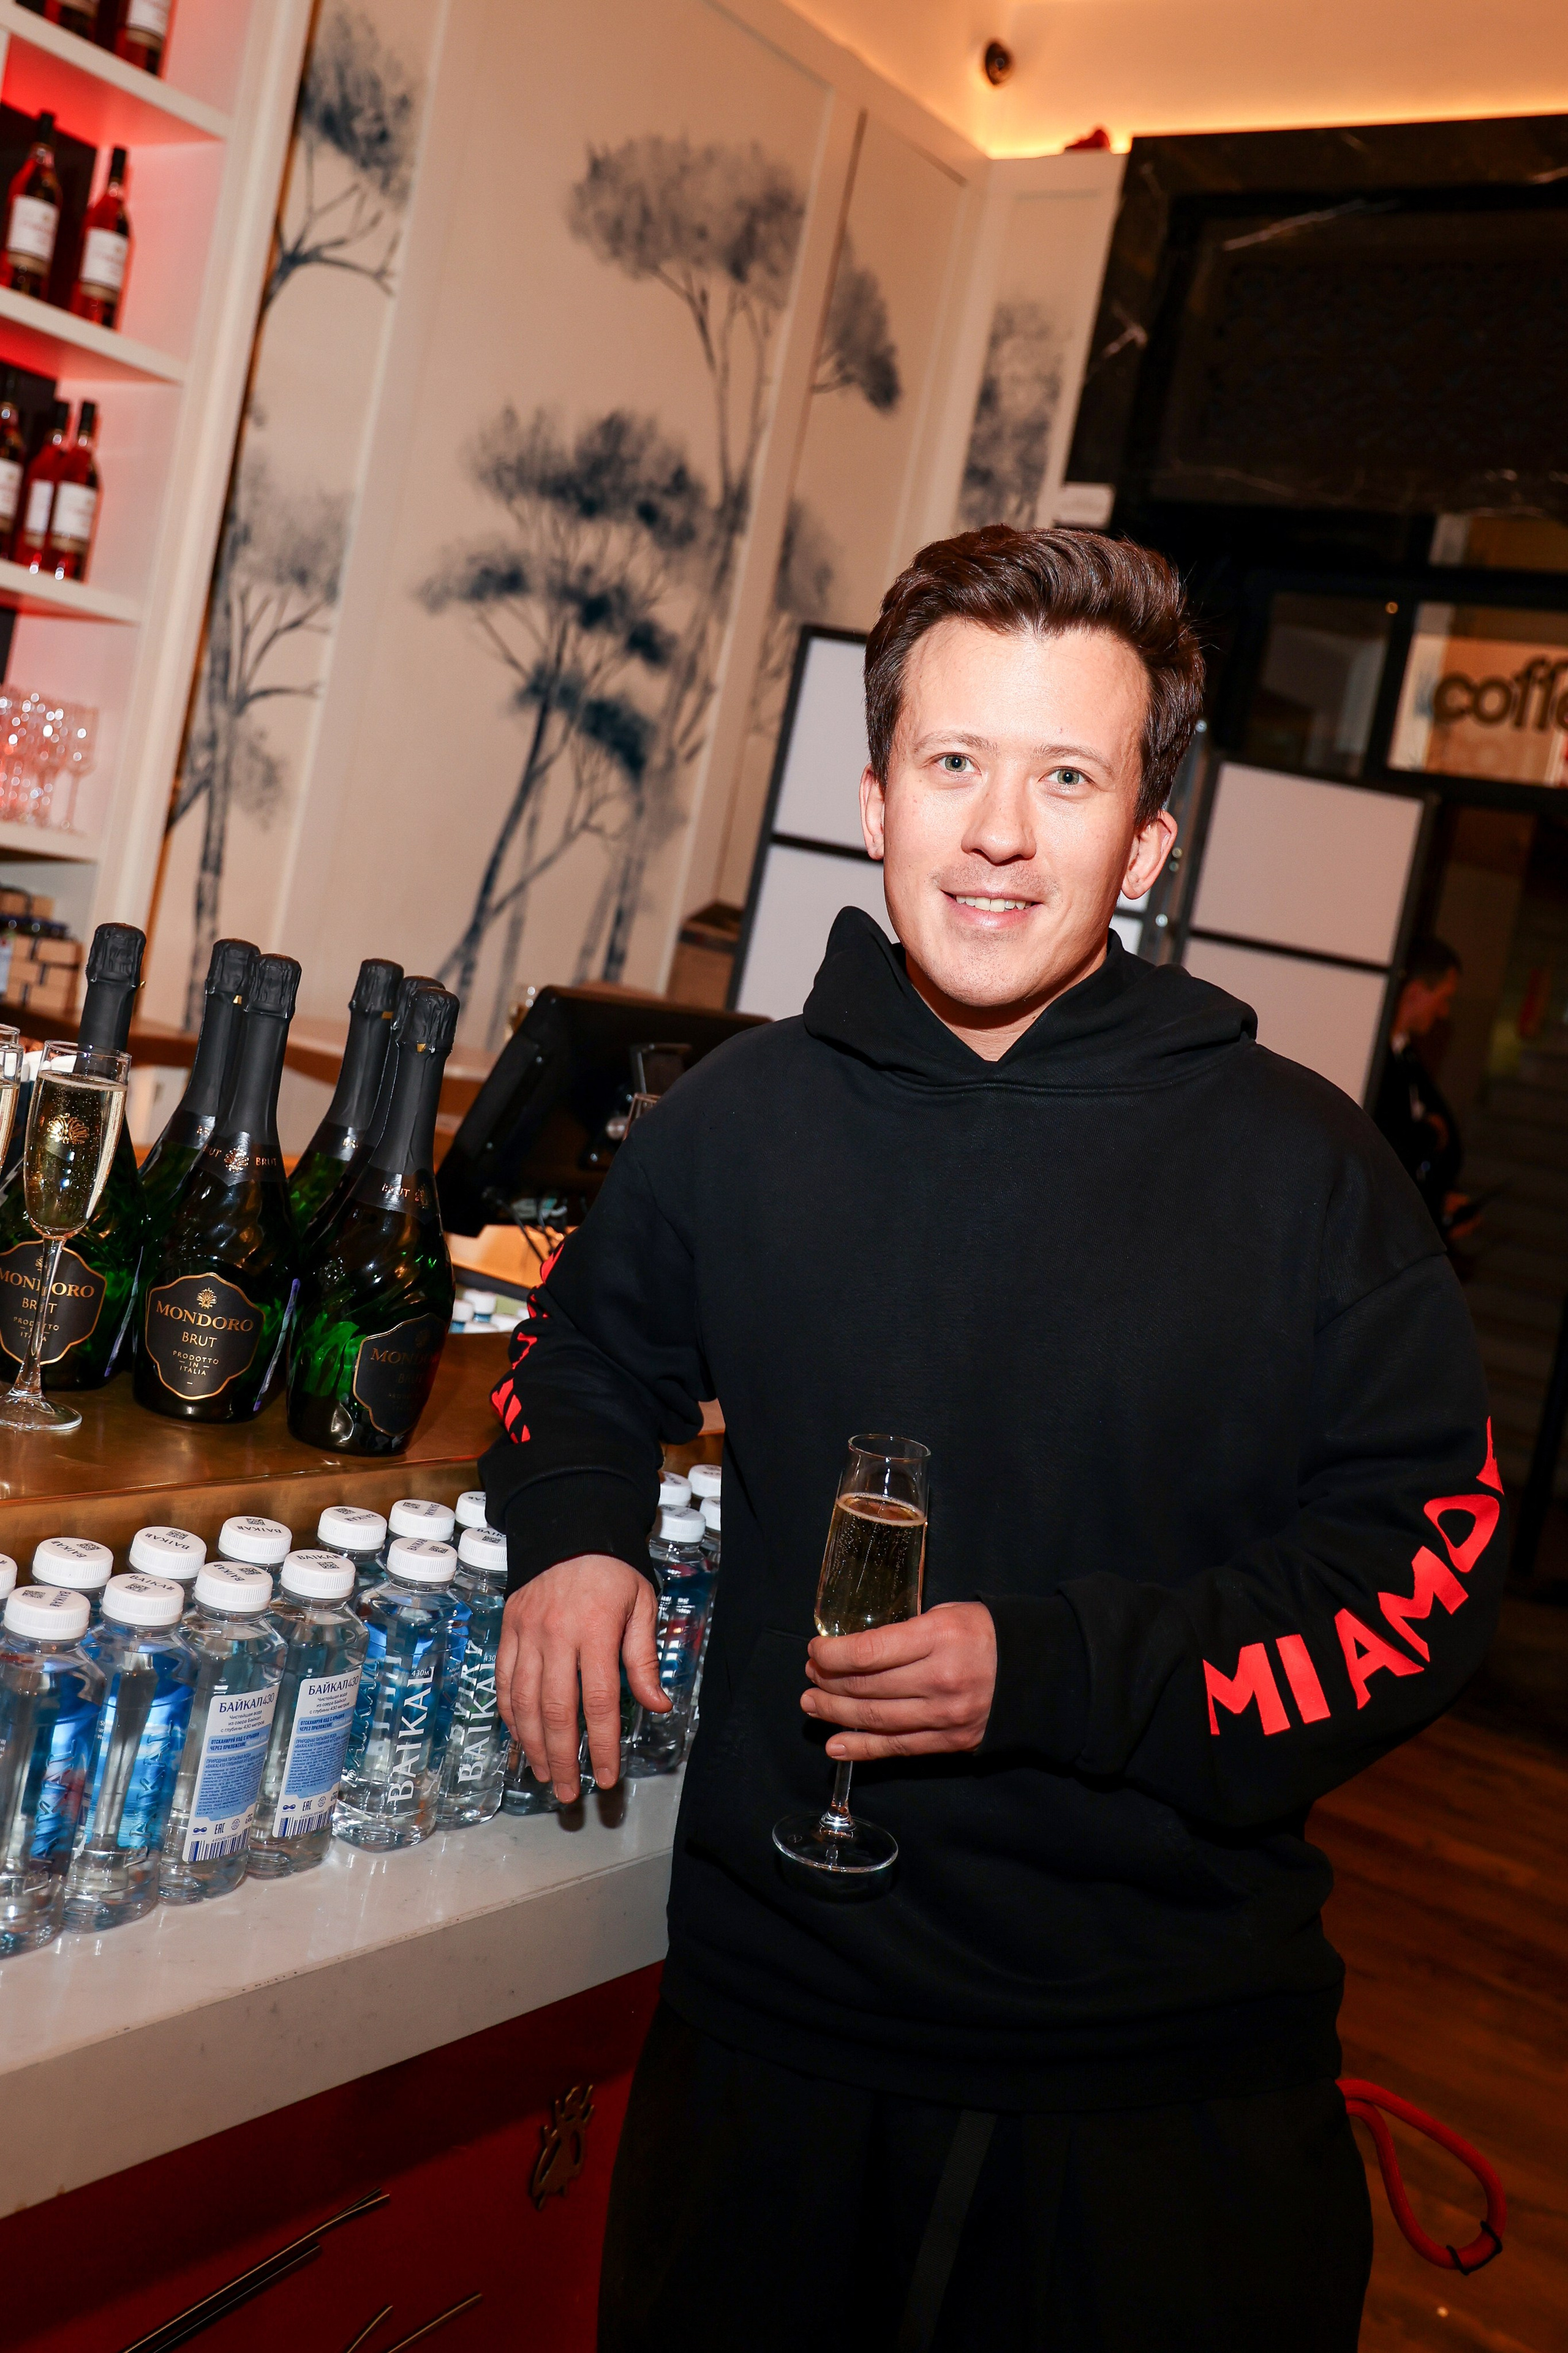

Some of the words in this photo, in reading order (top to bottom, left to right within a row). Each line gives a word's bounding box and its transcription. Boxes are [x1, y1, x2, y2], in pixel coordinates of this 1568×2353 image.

[255, 1157, 277, 1166] BRUT
[21, 1297, 58, 1314] BRT
[156, 1300, 254, 1332] MONDORO
[181, 1331, 218, 1348] BRUT
[172, 1350, 219, 1365] PRODOTTO
[179, 1365, 207, 1376] ITALIA
[483, 1653, 496, 1663] 430
[311, 1722, 333, 1731] ПРИЛОЖЕНИЕ
[386, 1666, 435, 1804] BAIKAL
[222, 1742, 246, 1750] ПРИЛОЖЕНИЕ
